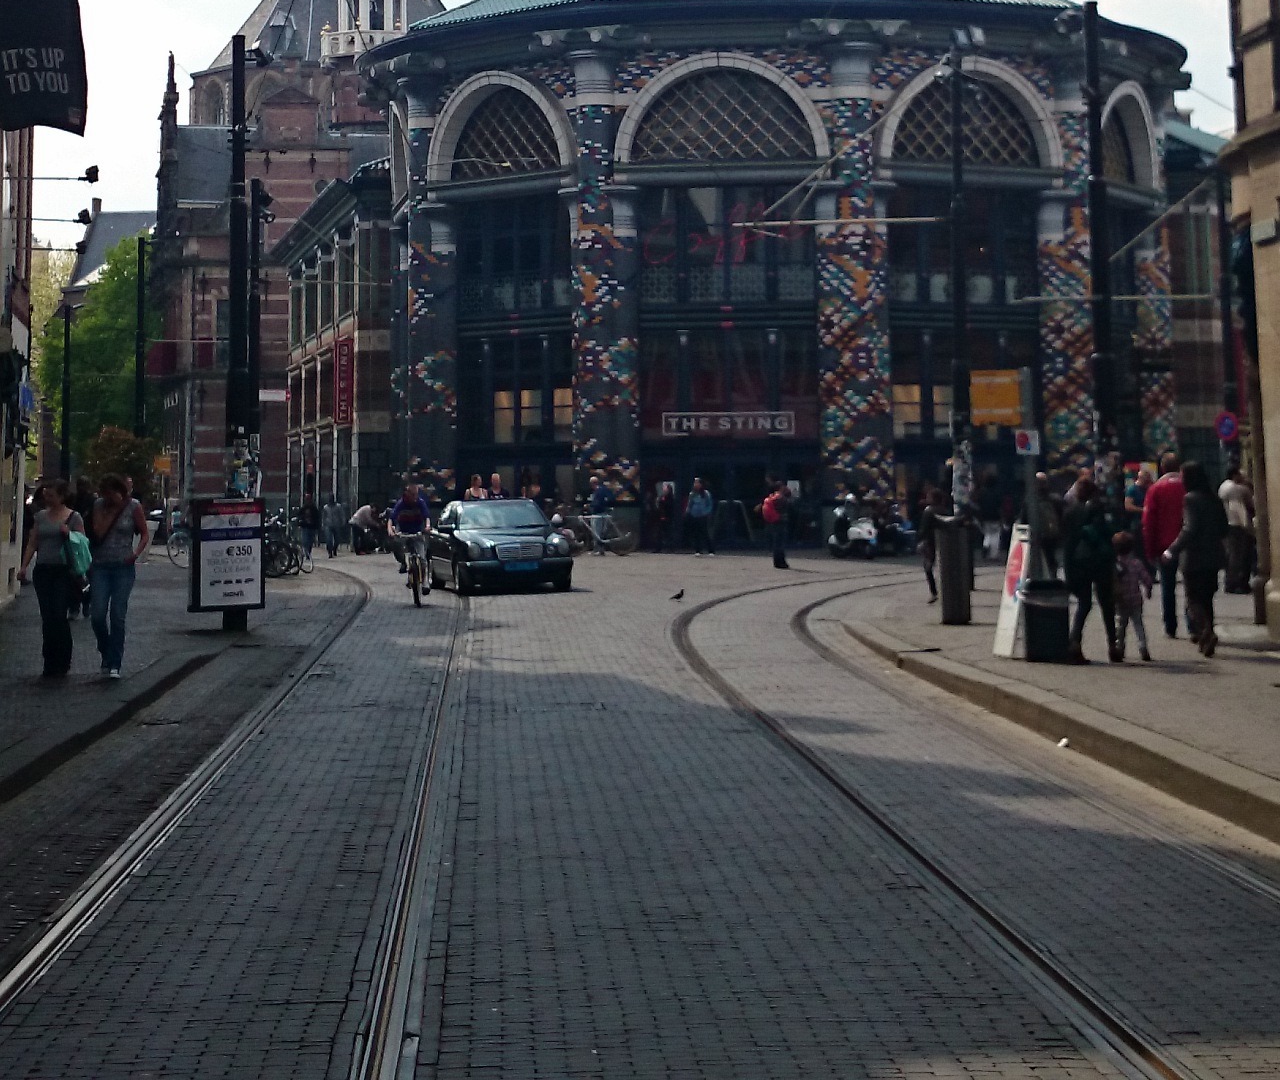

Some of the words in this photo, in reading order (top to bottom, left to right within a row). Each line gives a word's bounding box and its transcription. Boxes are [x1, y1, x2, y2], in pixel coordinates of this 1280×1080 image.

[1, 47, 38, 71] IT'S
[41, 47, 64, 69] UP
[4, 72, 31, 95] TO
[33, 71, 69, 94] YOU
[668, 417, 709, 430] THE
[718, 416, 789, 430] STING
